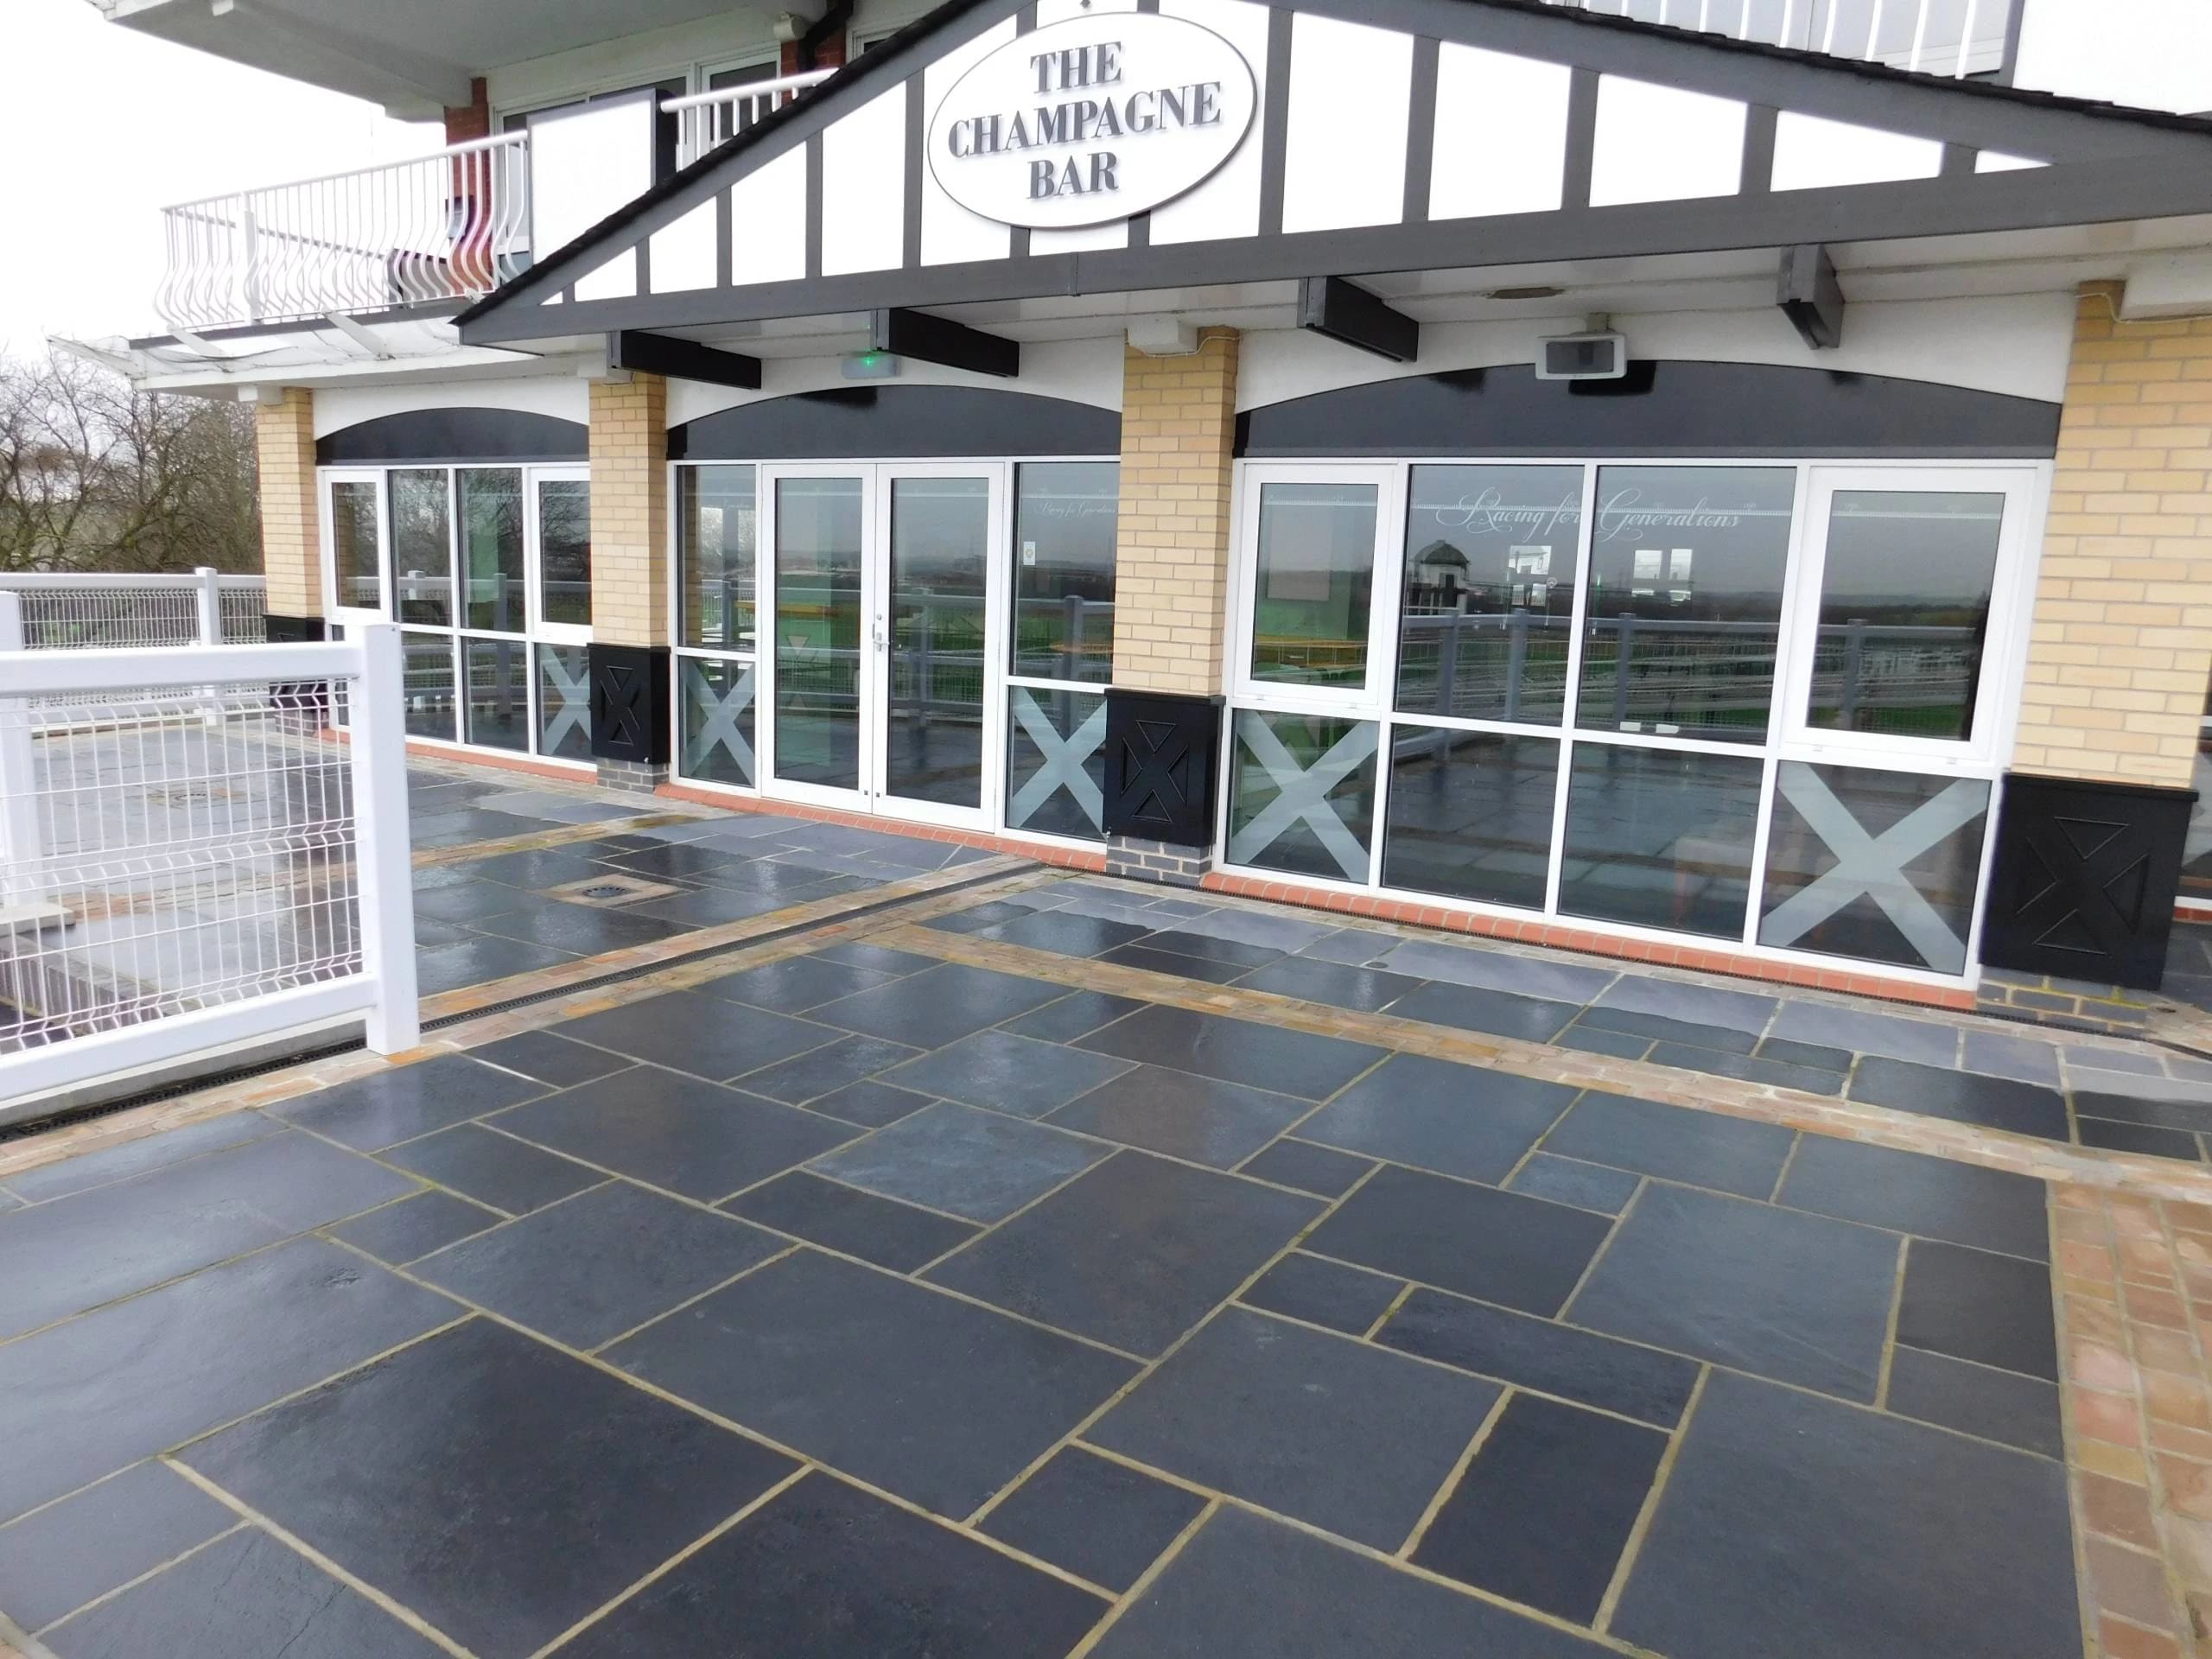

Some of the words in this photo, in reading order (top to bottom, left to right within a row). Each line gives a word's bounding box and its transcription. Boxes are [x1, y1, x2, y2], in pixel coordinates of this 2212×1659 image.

[1030, 41, 1122, 93] THE
[948, 81, 1221, 158] CHAMPAGNE
[1027, 151, 1119, 200] BAR
[1436, 486, 1546, 543] Racing
[1544, 492, 1580, 536] for
[1597, 487, 1740, 542] Generations
